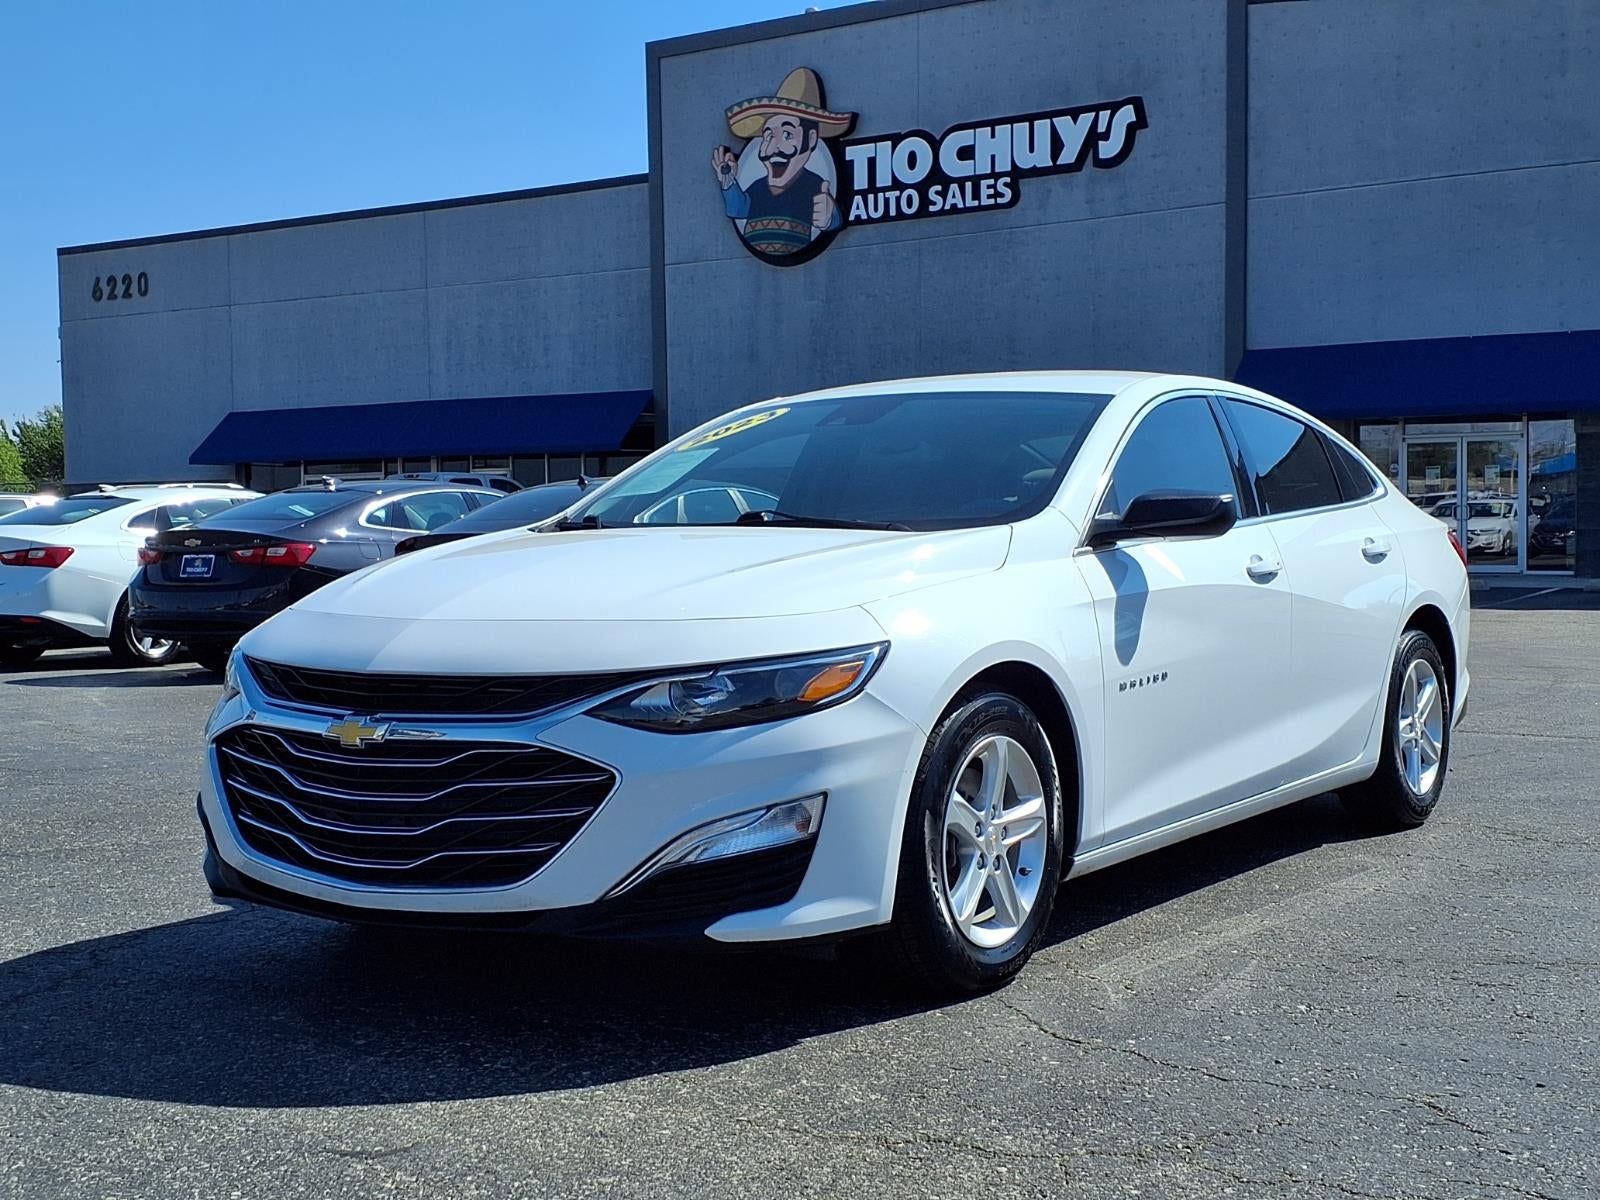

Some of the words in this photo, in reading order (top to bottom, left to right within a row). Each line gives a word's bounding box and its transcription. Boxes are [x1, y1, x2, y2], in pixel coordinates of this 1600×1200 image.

[845, 136, 933, 190] TIO
[939, 104, 1137, 178] CHUY'S
[848, 188, 919, 221] AUTO
[928, 177, 1012, 212] SALES
[92, 271, 149, 302] 6220
